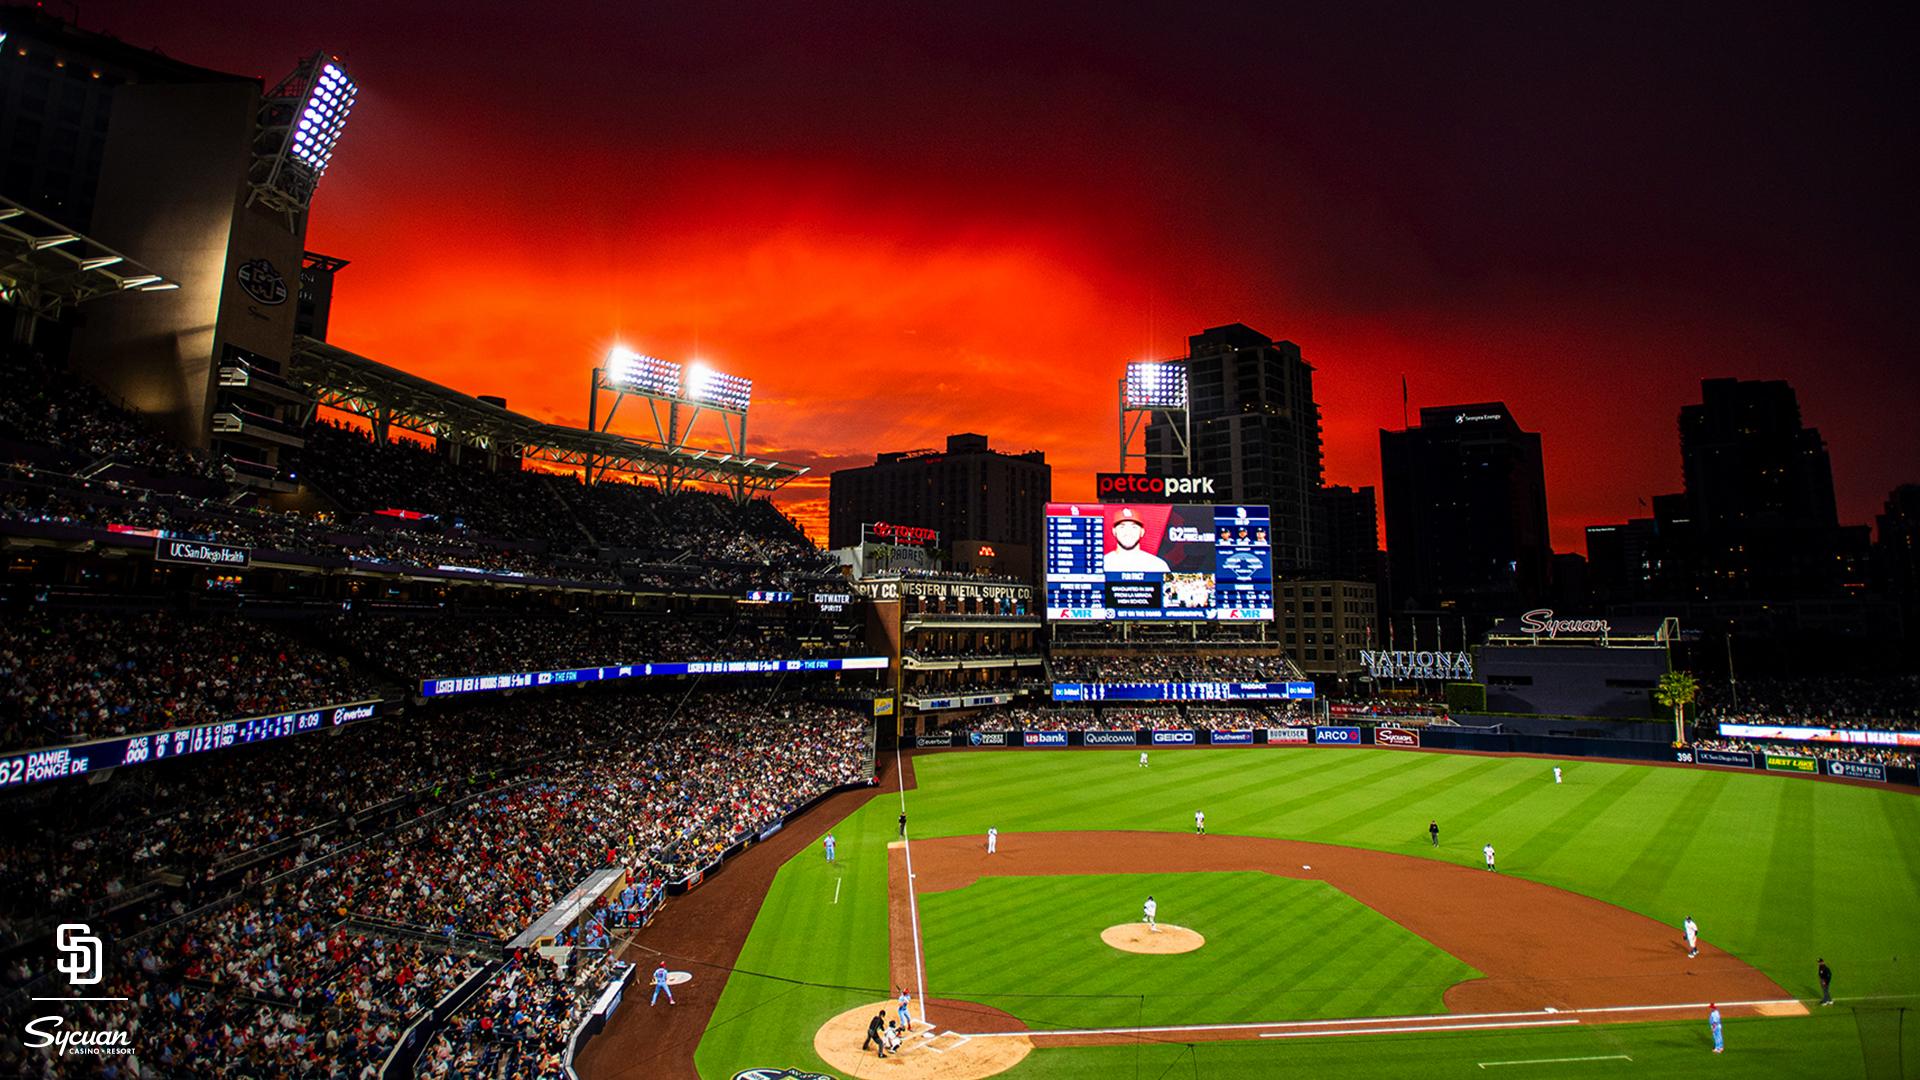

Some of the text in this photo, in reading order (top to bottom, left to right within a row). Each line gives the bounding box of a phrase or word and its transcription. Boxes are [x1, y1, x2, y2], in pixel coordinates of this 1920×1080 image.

[894, 525, 937, 540] TOYOTA
[1169, 527, 1184, 542] 62
[170, 543, 244, 563] UC San Diego Health
[882, 583, 899, 598] CO.
[901, 582, 1032, 600] WESTERN METAL SUPPLY CO.
[815, 594, 850, 604] CUTWATER
[1521, 609, 1611, 639] Sycuan
[804, 660, 815, 669] THE
[816, 660, 828, 669] FAN
[554, 671, 565, 682] THE
[566, 670, 578, 681] FAN
[1370, 665, 1473, 680] UNIVERSITY
[299, 712, 319, 729] 8:09
[223, 723, 238, 734] STL
[283, 723, 290, 736] 3
[1270, 730, 1305, 738] BUDWEISER
[1317, 731, 1348, 741] ARCO
[128, 730, 190, 750] AVG HR RBI
[194, 734, 220, 752] 0 2 1
[221, 733, 234, 746] SD
[260, 728, 267, 740] 5
[924, 737, 951, 745] everbowl
[1086, 733, 1135, 743] Qualcomm
[1154, 733, 1193, 742] GEICO
[1214, 733, 1246, 741] Southwest
[1379, 730, 1412, 743] Sycuan
[28, 749, 71, 768] DANIEL
[122, 741, 185, 766] .000 0 0
[1677, 752, 1692, 762] 396
[0, 759, 24, 785] 62
[26, 758, 89, 783] PONCE DE
[1845, 764, 1880, 774] PENFED
